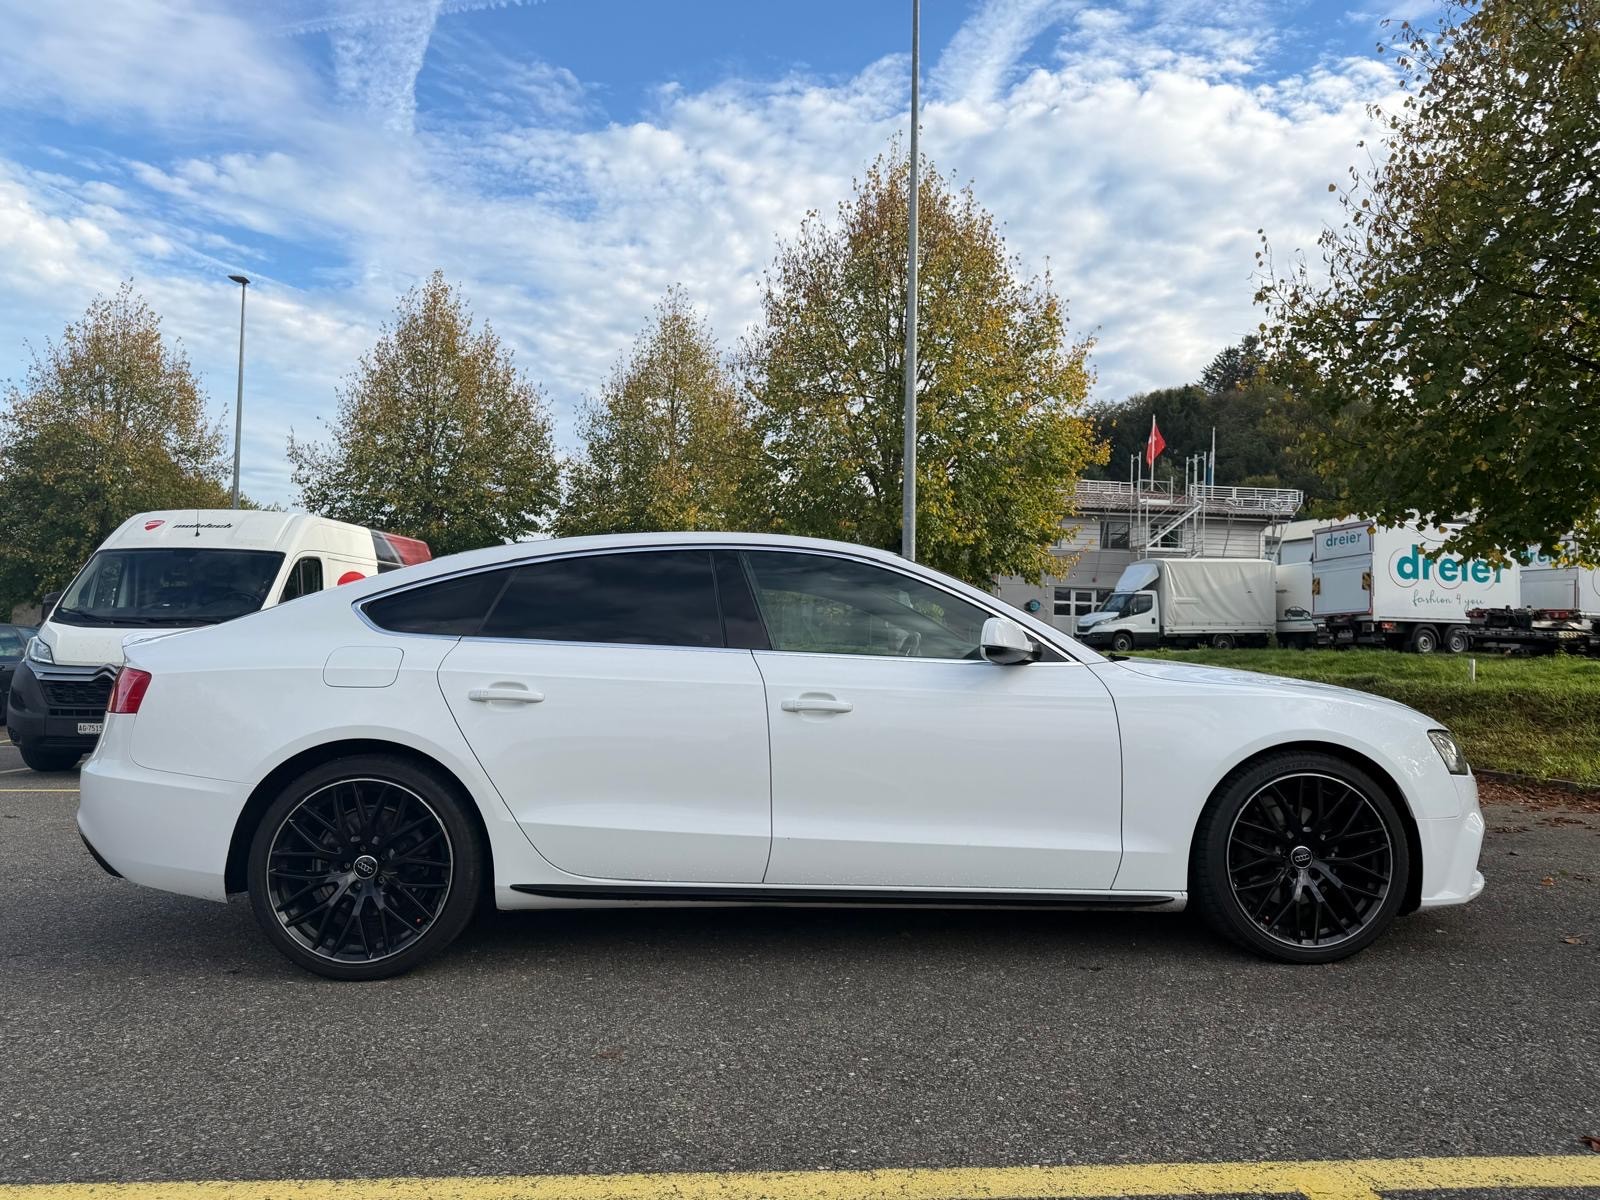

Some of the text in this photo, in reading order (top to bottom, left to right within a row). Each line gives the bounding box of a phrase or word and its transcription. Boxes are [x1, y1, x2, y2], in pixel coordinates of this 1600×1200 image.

[1326, 532, 1361, 547] dreier
[1412, 589, 1486, 612] fashion 4 you
